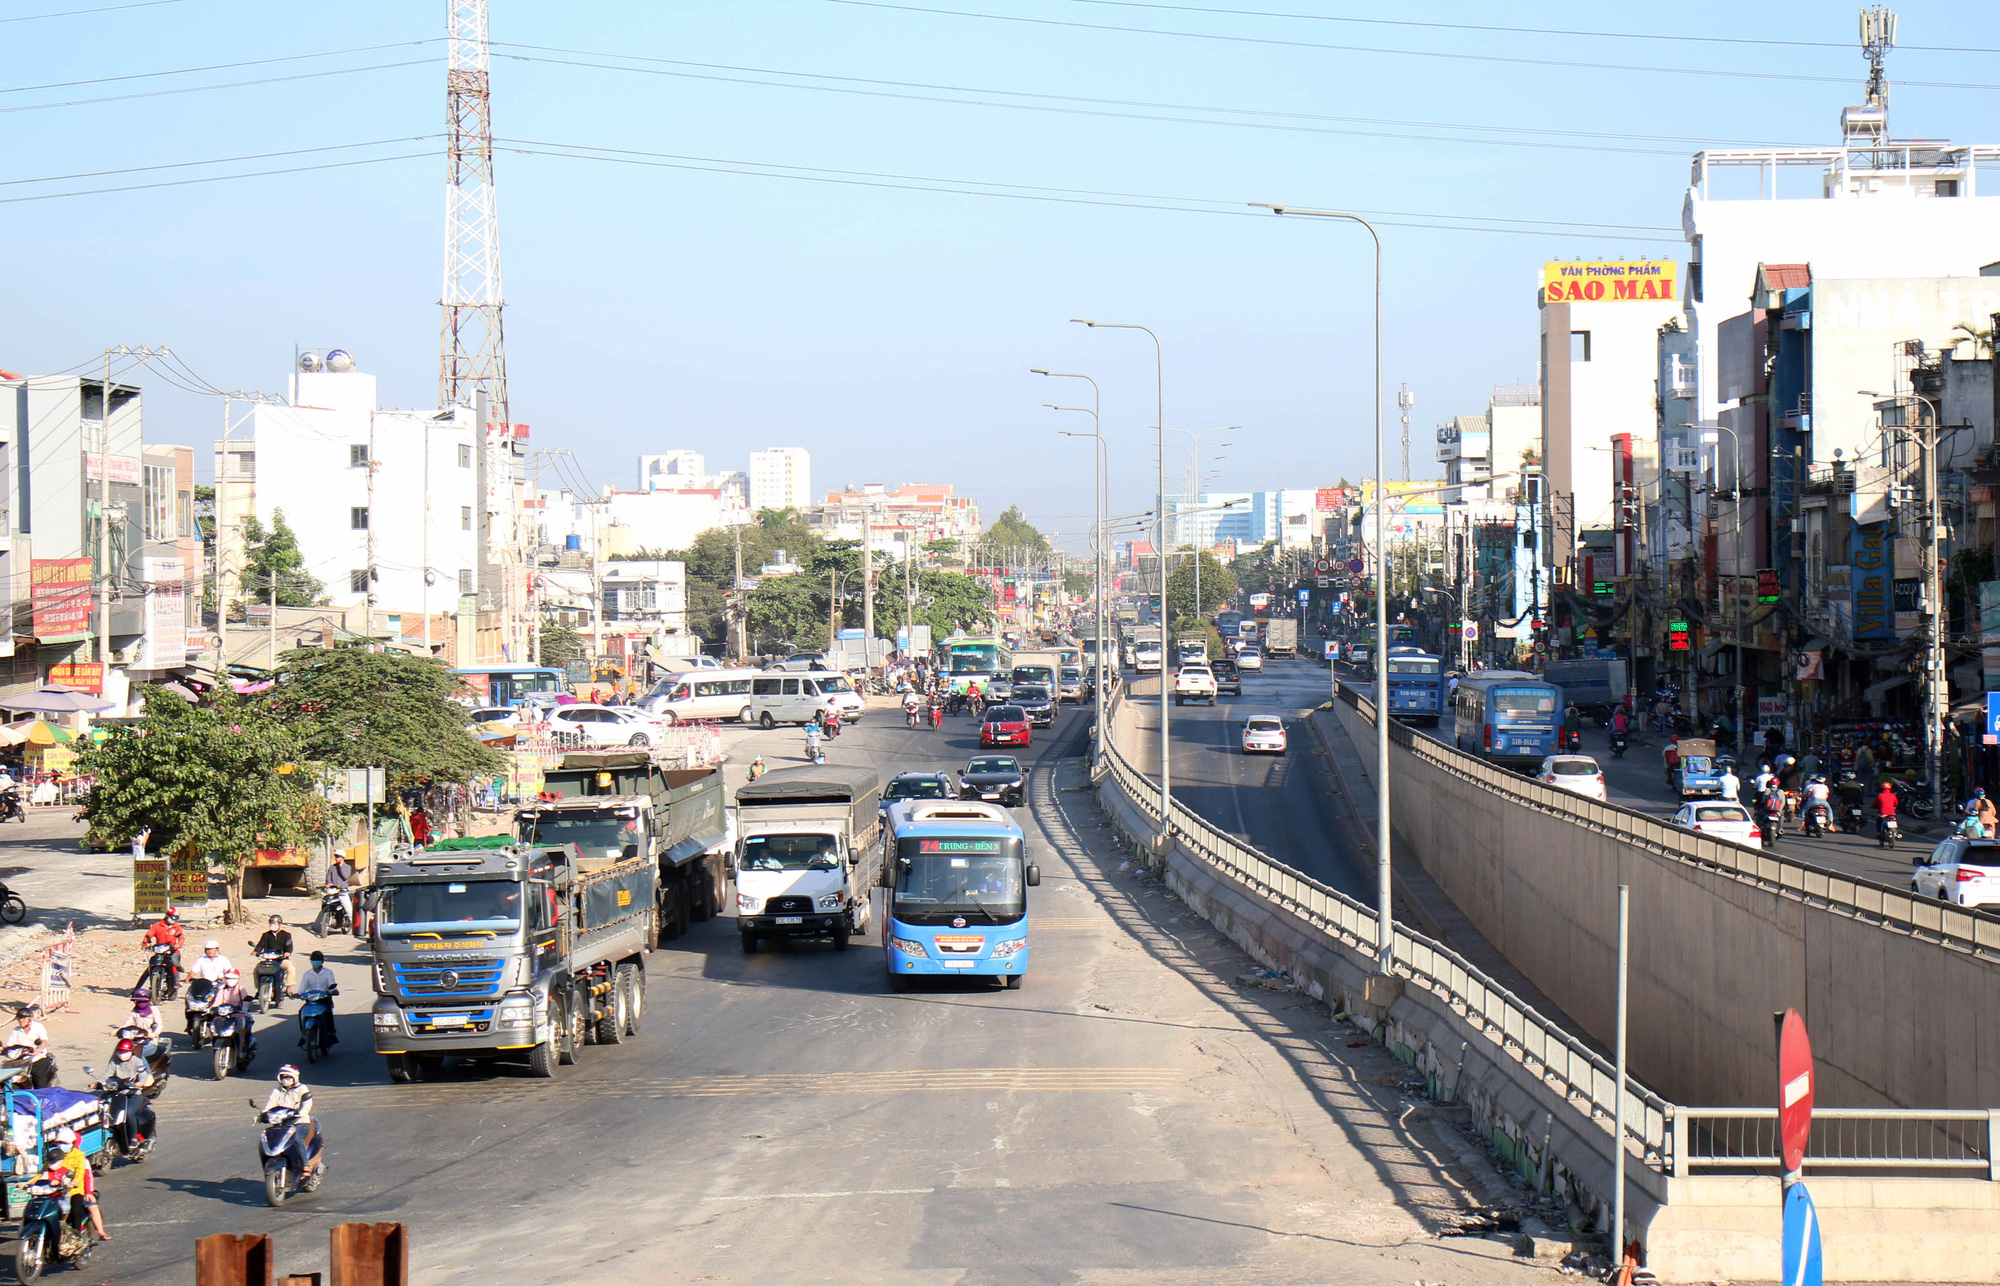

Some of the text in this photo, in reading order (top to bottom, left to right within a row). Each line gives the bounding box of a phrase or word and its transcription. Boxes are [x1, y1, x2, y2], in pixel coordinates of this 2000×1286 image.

[1560, 265, 1583, 276] VĂN
[1586, 264, 1625, 276] PHÒNG
[1547, 279, 1672, 301] SAO MAI
[1857, 576, 1885, 634] Villa
[921, 840, 940, 852] 74
[136, 861, 165, 873] HÙNG
[172, 874, 187, 883] XE
[412, 942, 452, 951] 현대자동차
[417, 952, 480, 962] SHACMAN
